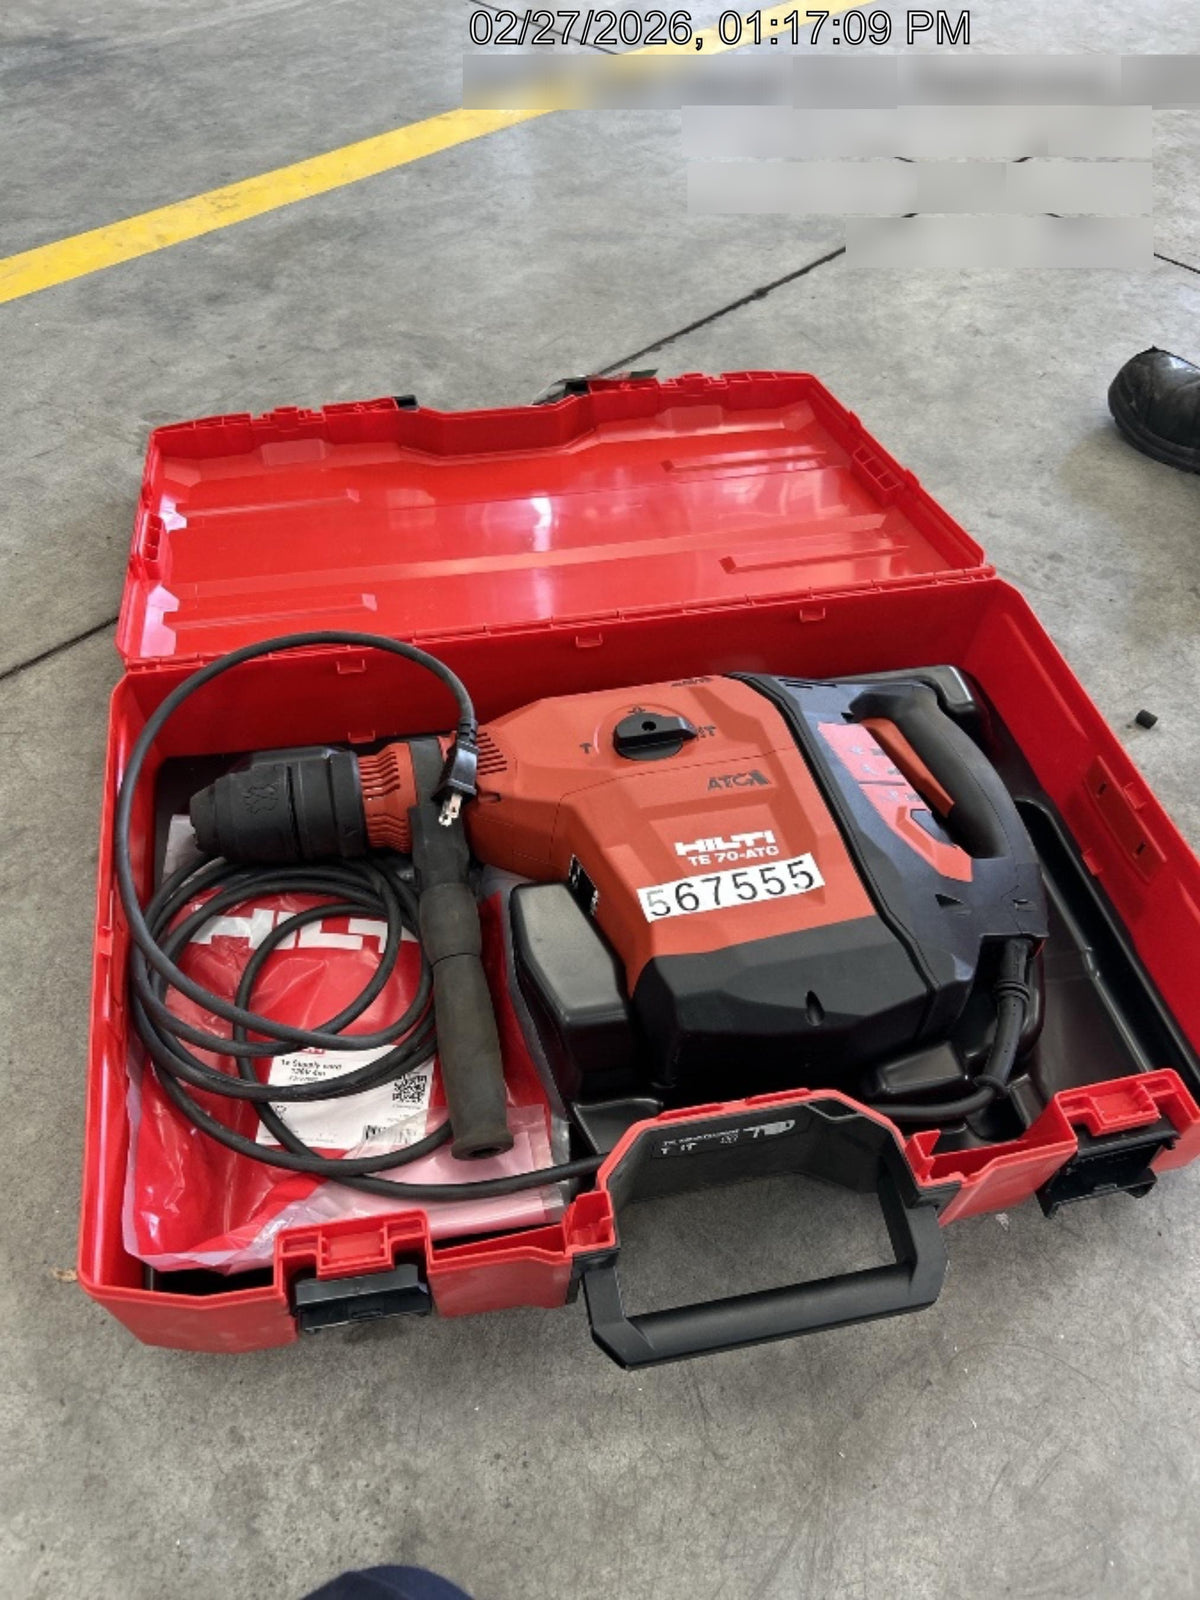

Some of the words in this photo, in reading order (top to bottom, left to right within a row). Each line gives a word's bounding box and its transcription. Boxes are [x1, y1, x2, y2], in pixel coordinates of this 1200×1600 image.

[674, 829, 776, 856] HILTI
[688, 855, 712, 867] TE
[715, 845, 779, 864] 70-ATC
[646, 860, 814, 917] 567555
